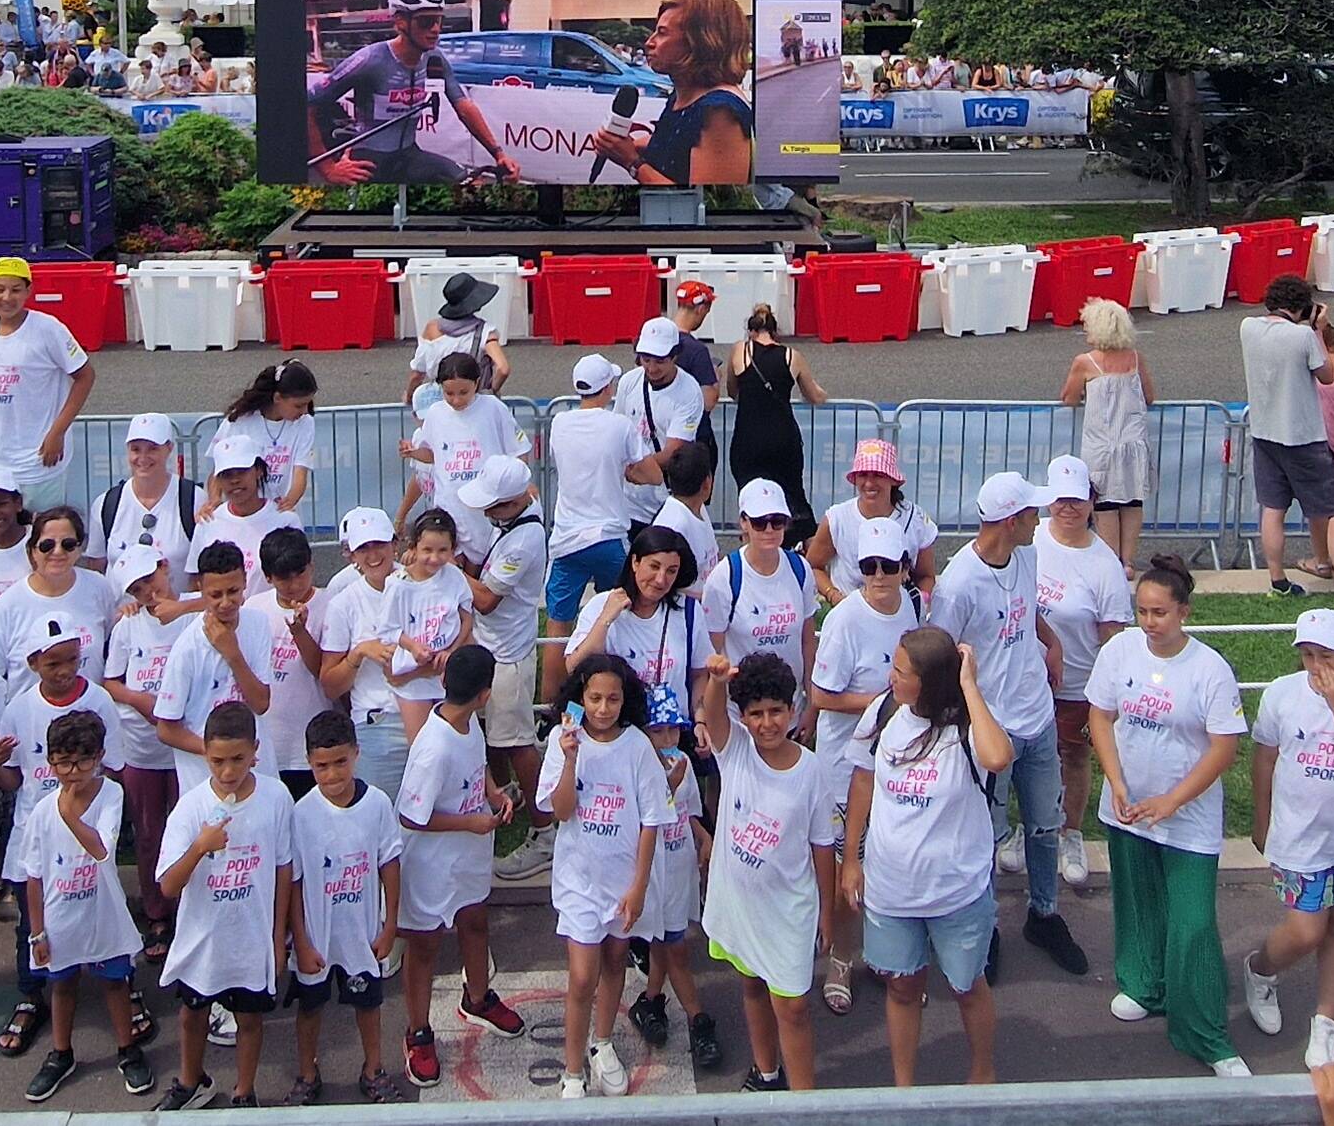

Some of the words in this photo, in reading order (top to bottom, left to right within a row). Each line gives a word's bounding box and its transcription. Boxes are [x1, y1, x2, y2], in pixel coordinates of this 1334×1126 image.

[841, 102, 884, 124] Krys
[974, 102, 1019, 123] Krys
[265, 454, 290, 464] POUR
[456, 450, 482, 459] POUR
[445, 461, 463, 471] QUE
[463, 461, 474, 470] LE
[449, 471, 478, 481] SPORT
[769, 613, 797, 624] POUR
[752, 625, 774, 637] QUE
[775, 624, 787, 634] LE
[79, 635, 92, 648] UR
[429, 634, 447, 650] ORT
[757, 634, 792, 646] SPORT
[151, 656, 167, 668] PO
[136, 669, 157, 681] QUE
[142, 680, 162, 692] SPO
[1123, 701, 1146, 716] QUE
[1146, 708, 1160, 720] LE
[1139, 694, 1172, 714] POUR
[1127, 716, 1164, 733] SPORT
[1297, 752, 1322, 766] QUE
[34, 768, 53, 780] QU
[907, 769, 938, 782] POUR
[887, 780, 910, 794] QUE
[913, 782, 927, 795] LE
[594, 795, 626, 810] POUR
[896, 795, 933, 808] SPORT
[577, 806, 599, 821] QUE
[602, 810, 614, 823] LE
[582, 823, 622, 837] SPORT
[746, 823, 780, 846] POUR
[664, 836, 687, 852] PORT
[748, 839, 764, 855] LE
[226, 856, 261, 873] POUR
[56, 879, 78, 893] QUE
[83, 876, 96, 888] LE
[207, 875, 231, 891] QUE
[234, 873, 249, 887] LE
[324, 879, 348, 895] QUE
[352, 877, 362, 891] LE
[213, 885, 255, 902] SPORT
[331, 889, 364, 905] SPOR
